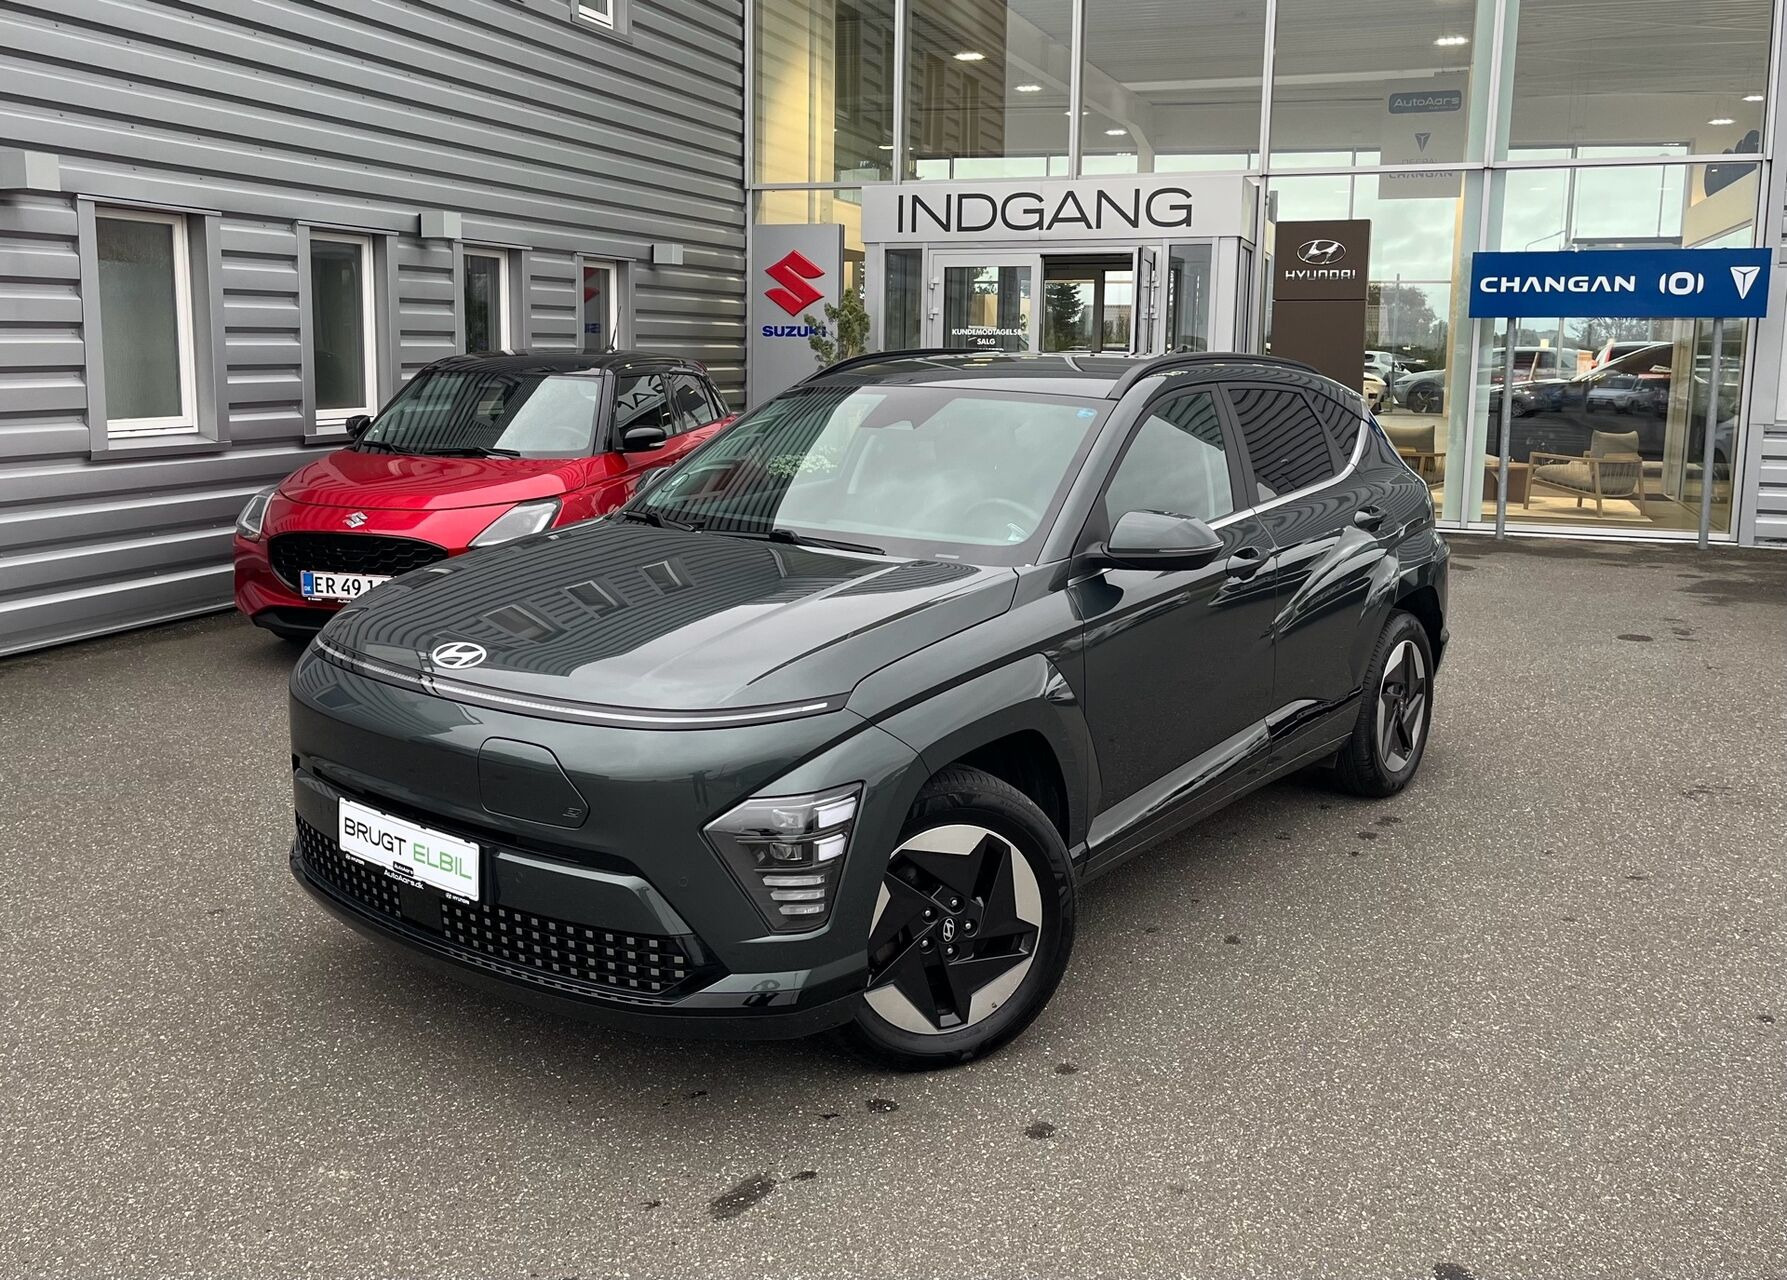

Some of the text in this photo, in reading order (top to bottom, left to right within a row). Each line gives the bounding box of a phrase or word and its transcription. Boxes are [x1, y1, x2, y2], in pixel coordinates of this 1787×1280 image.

[897, 187, 1193, 233] INDGANG
[1285, 269, 1356, 280] HYUNDAI
[1479, 275, 1636, 293] CHANGAN
[315, 577, 336, 594] ER
[341, 578, 361, 596] 49
[344, 816, 473, 880] BRUGT ELBIL
